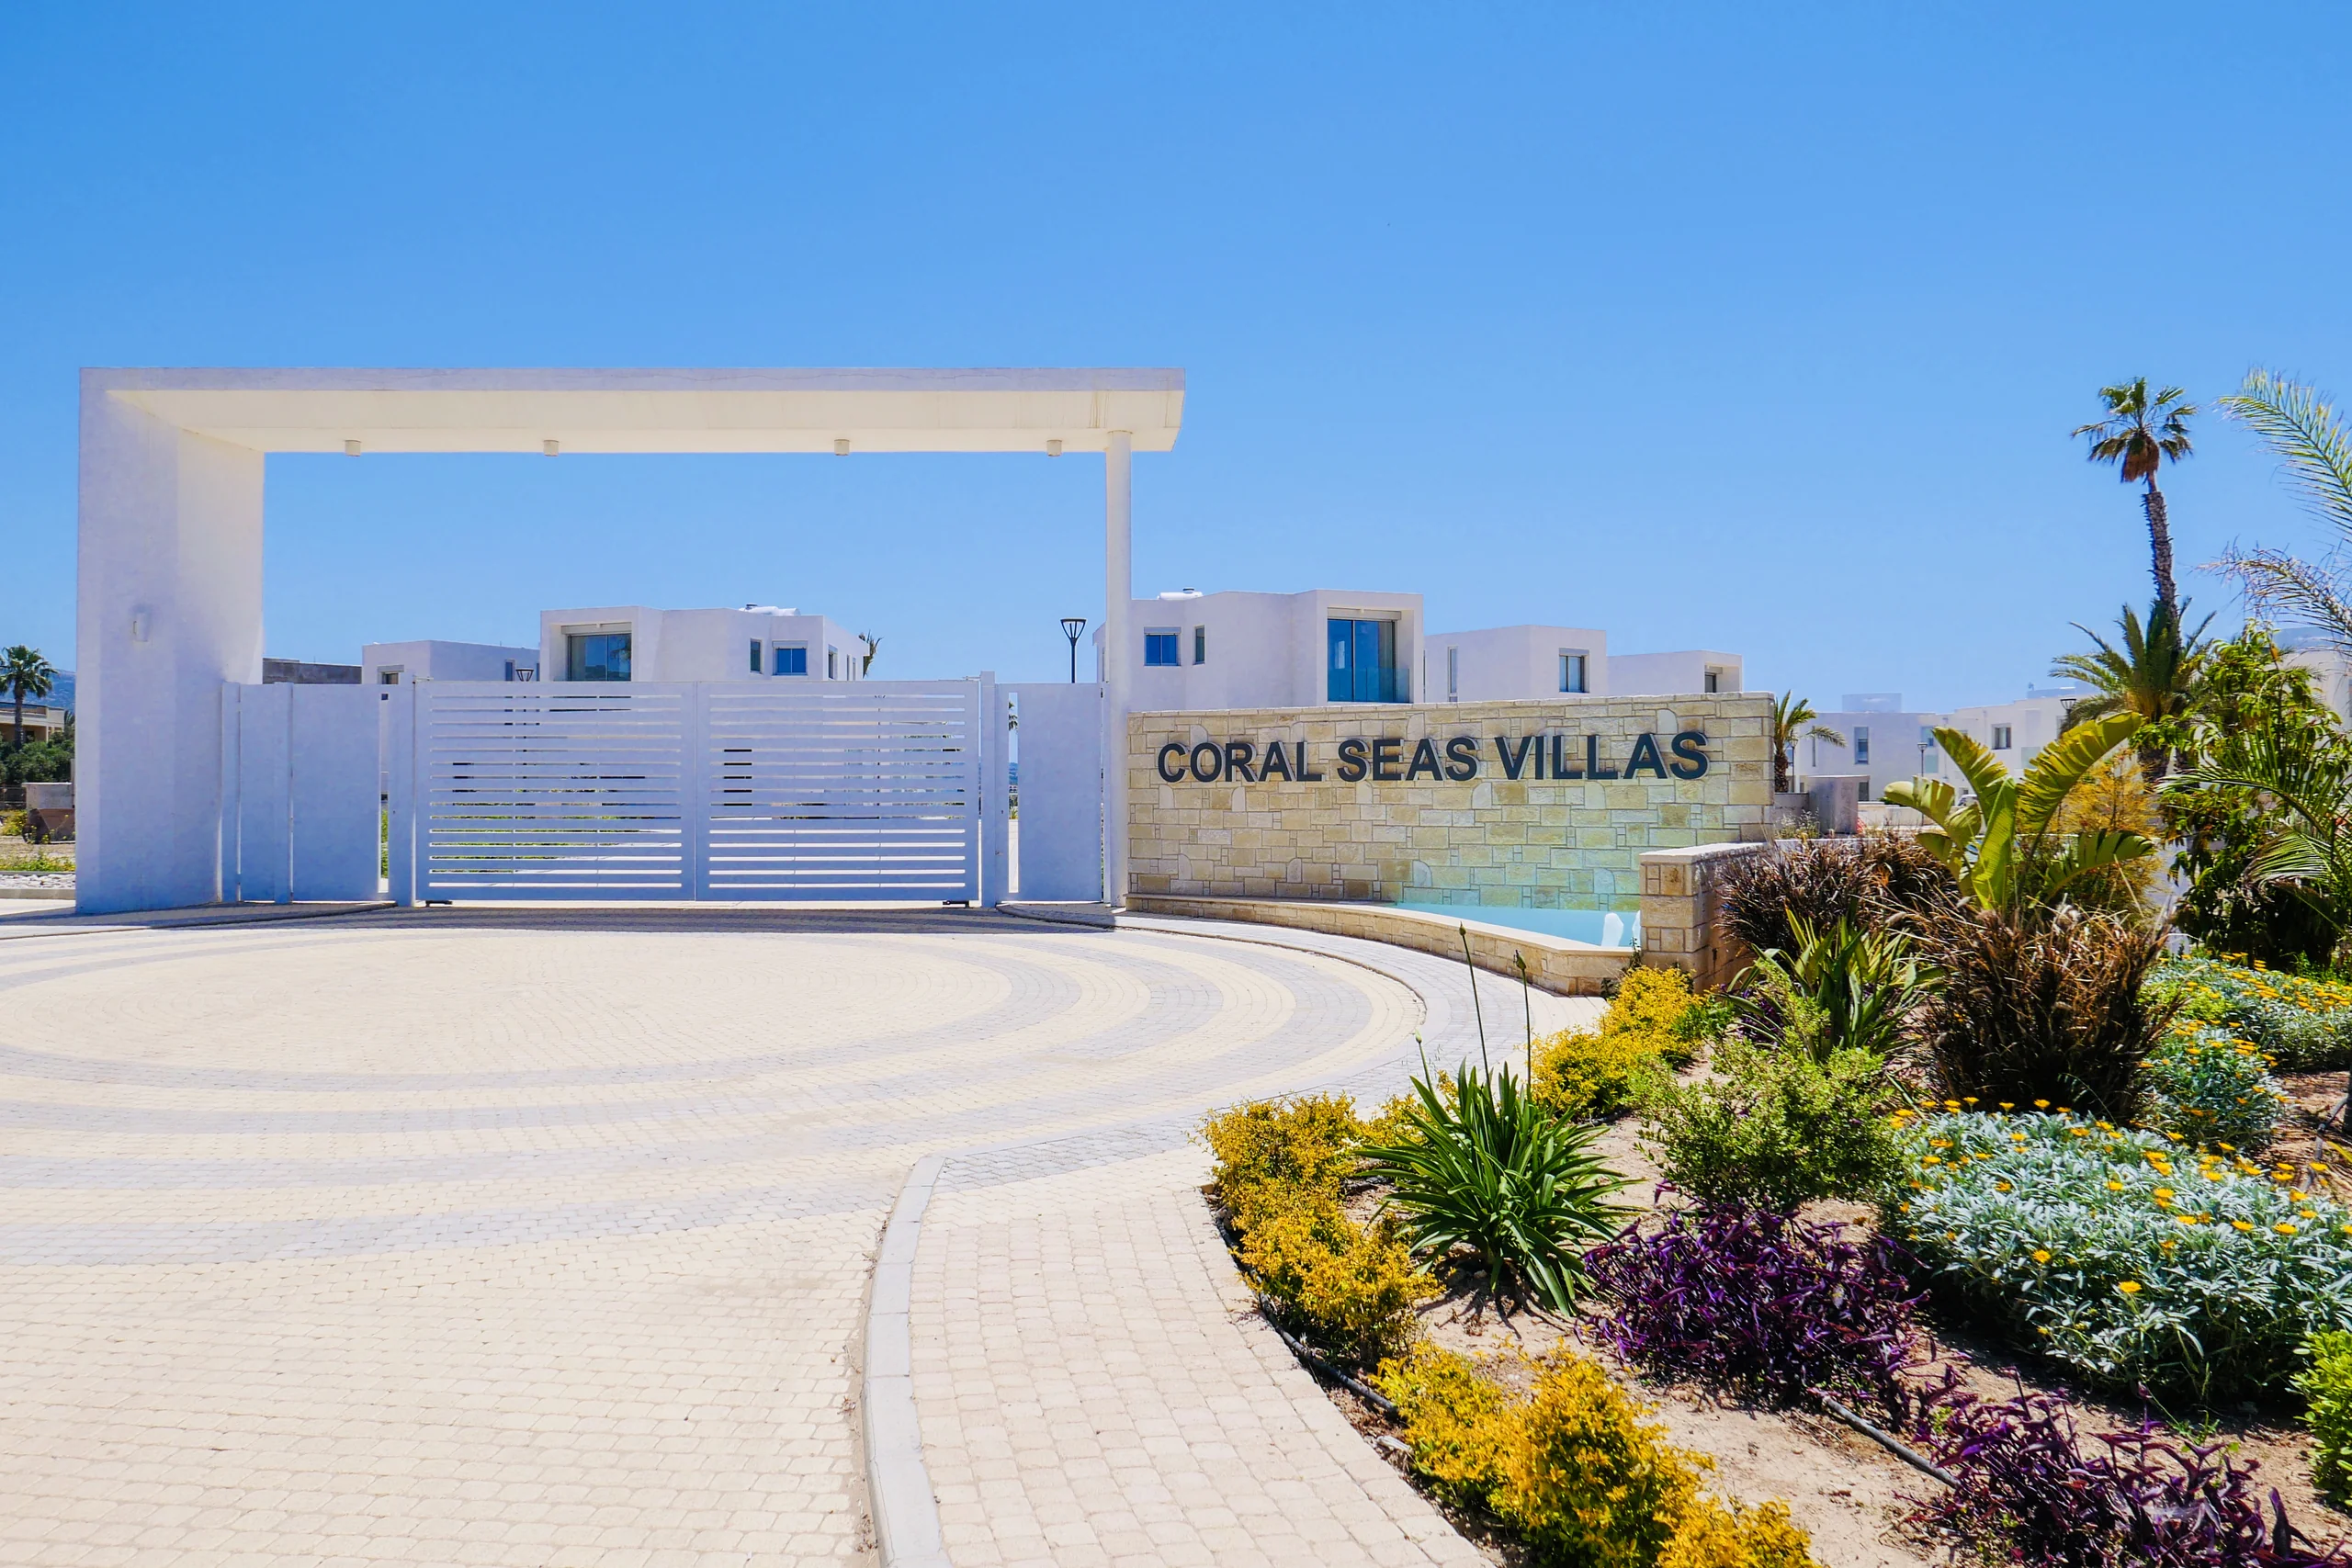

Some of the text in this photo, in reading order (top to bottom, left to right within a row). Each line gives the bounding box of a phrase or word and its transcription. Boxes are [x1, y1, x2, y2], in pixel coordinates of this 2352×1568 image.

[1158, 732, 1710, 783] CORAL SEAS VILLAS
